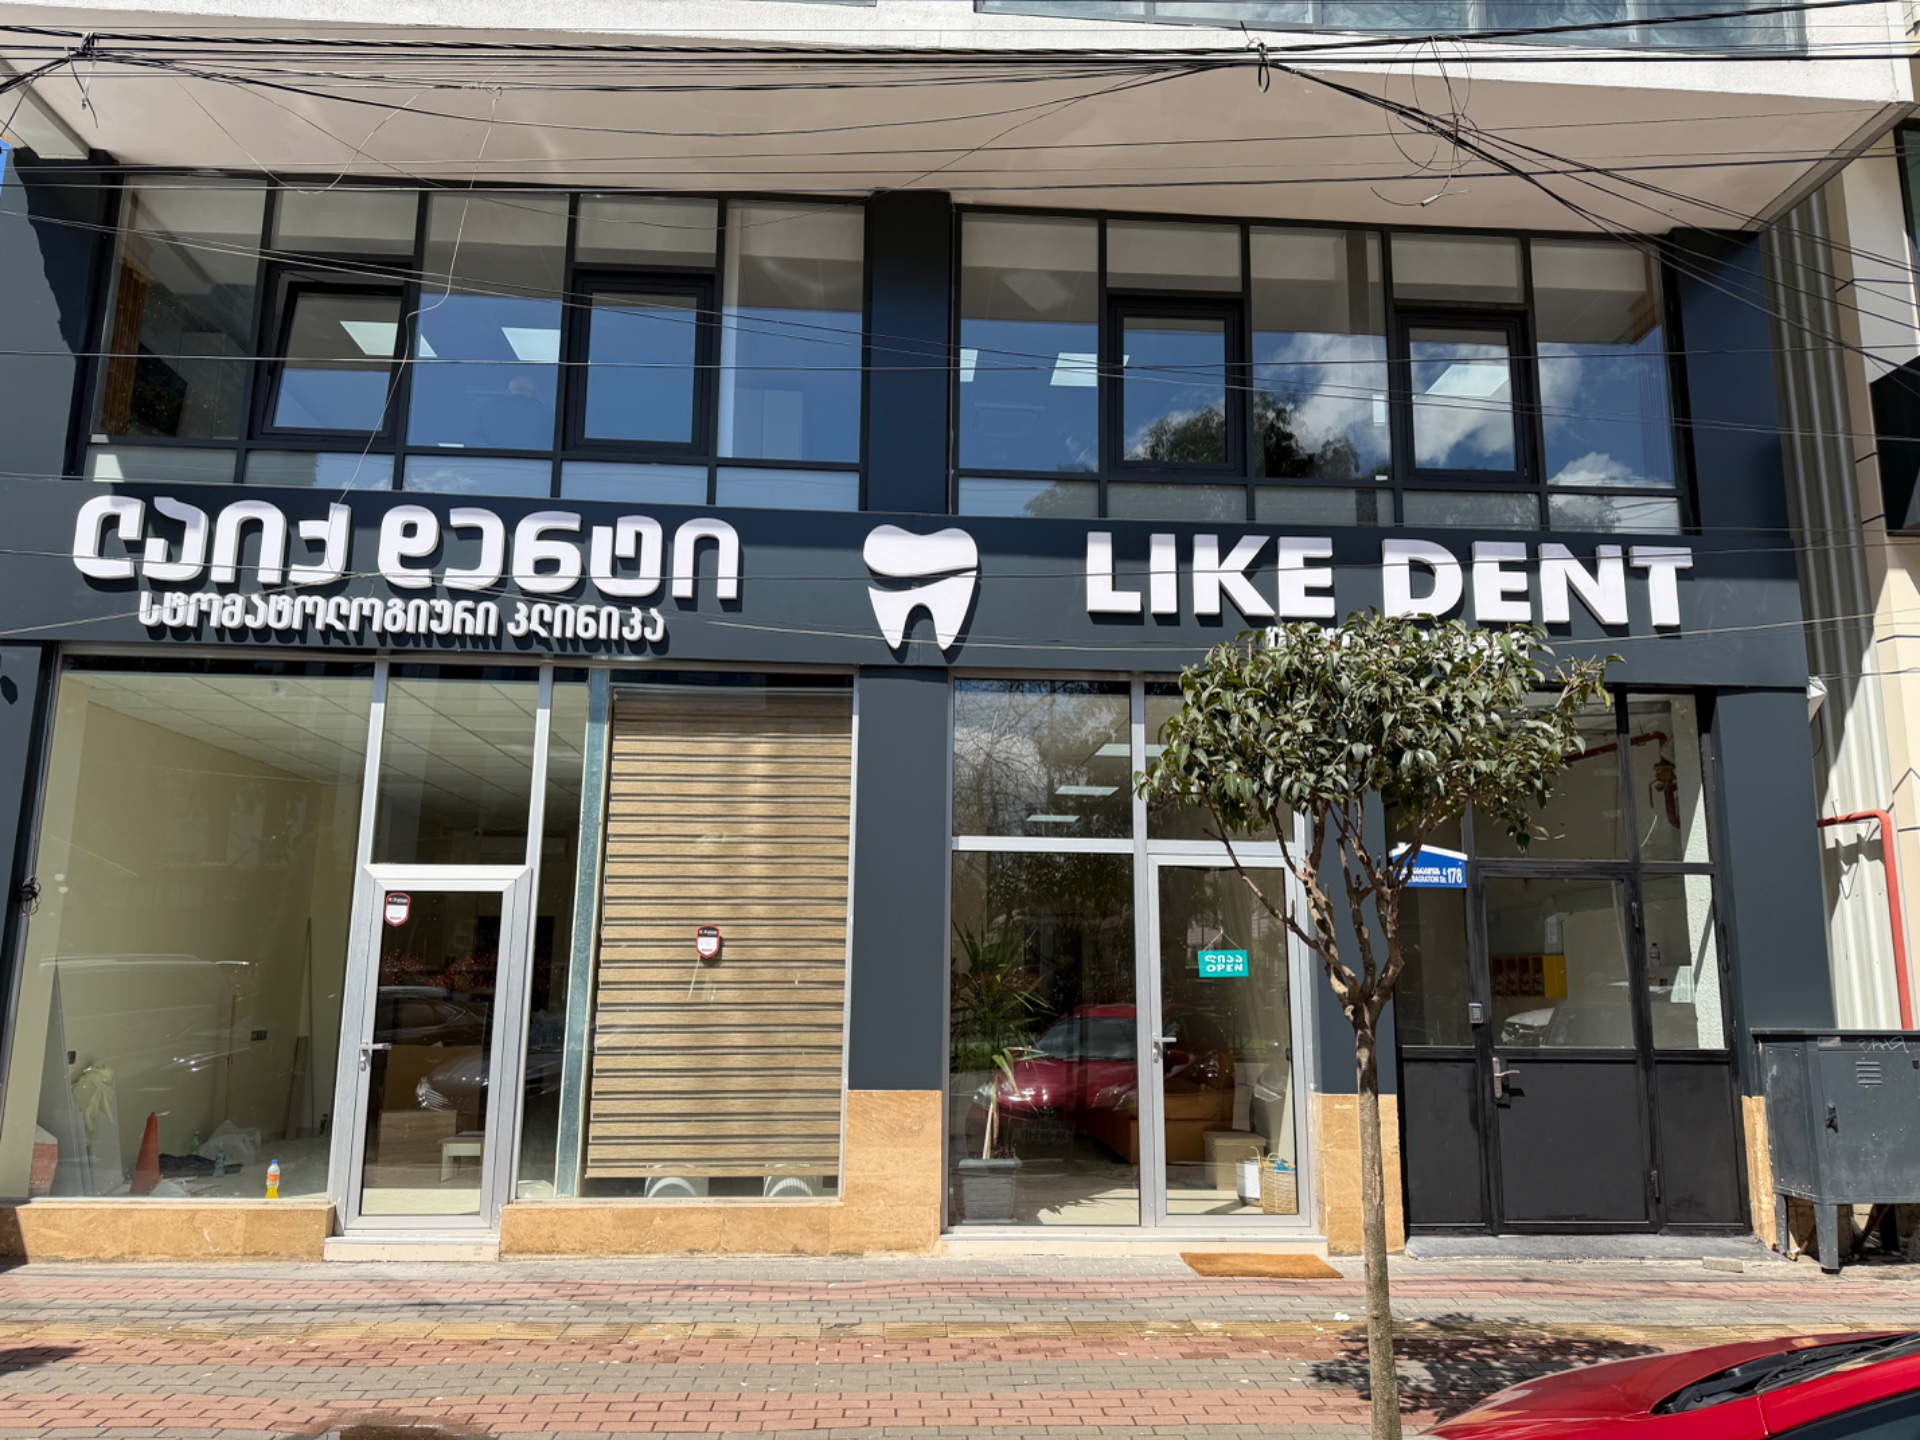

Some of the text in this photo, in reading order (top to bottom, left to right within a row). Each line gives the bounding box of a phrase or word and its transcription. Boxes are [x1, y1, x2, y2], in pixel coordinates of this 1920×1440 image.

[73, 495, 740, 601] ლაიქ დენტი
[1086, 531, 1694, 627] LIKE DENT
[138, 591, 665, 642] სტომატოლოგიური კლინიკა
[1447, 867, 1463, 884] 178
[1205, 963, 1244, 973] OPEN
